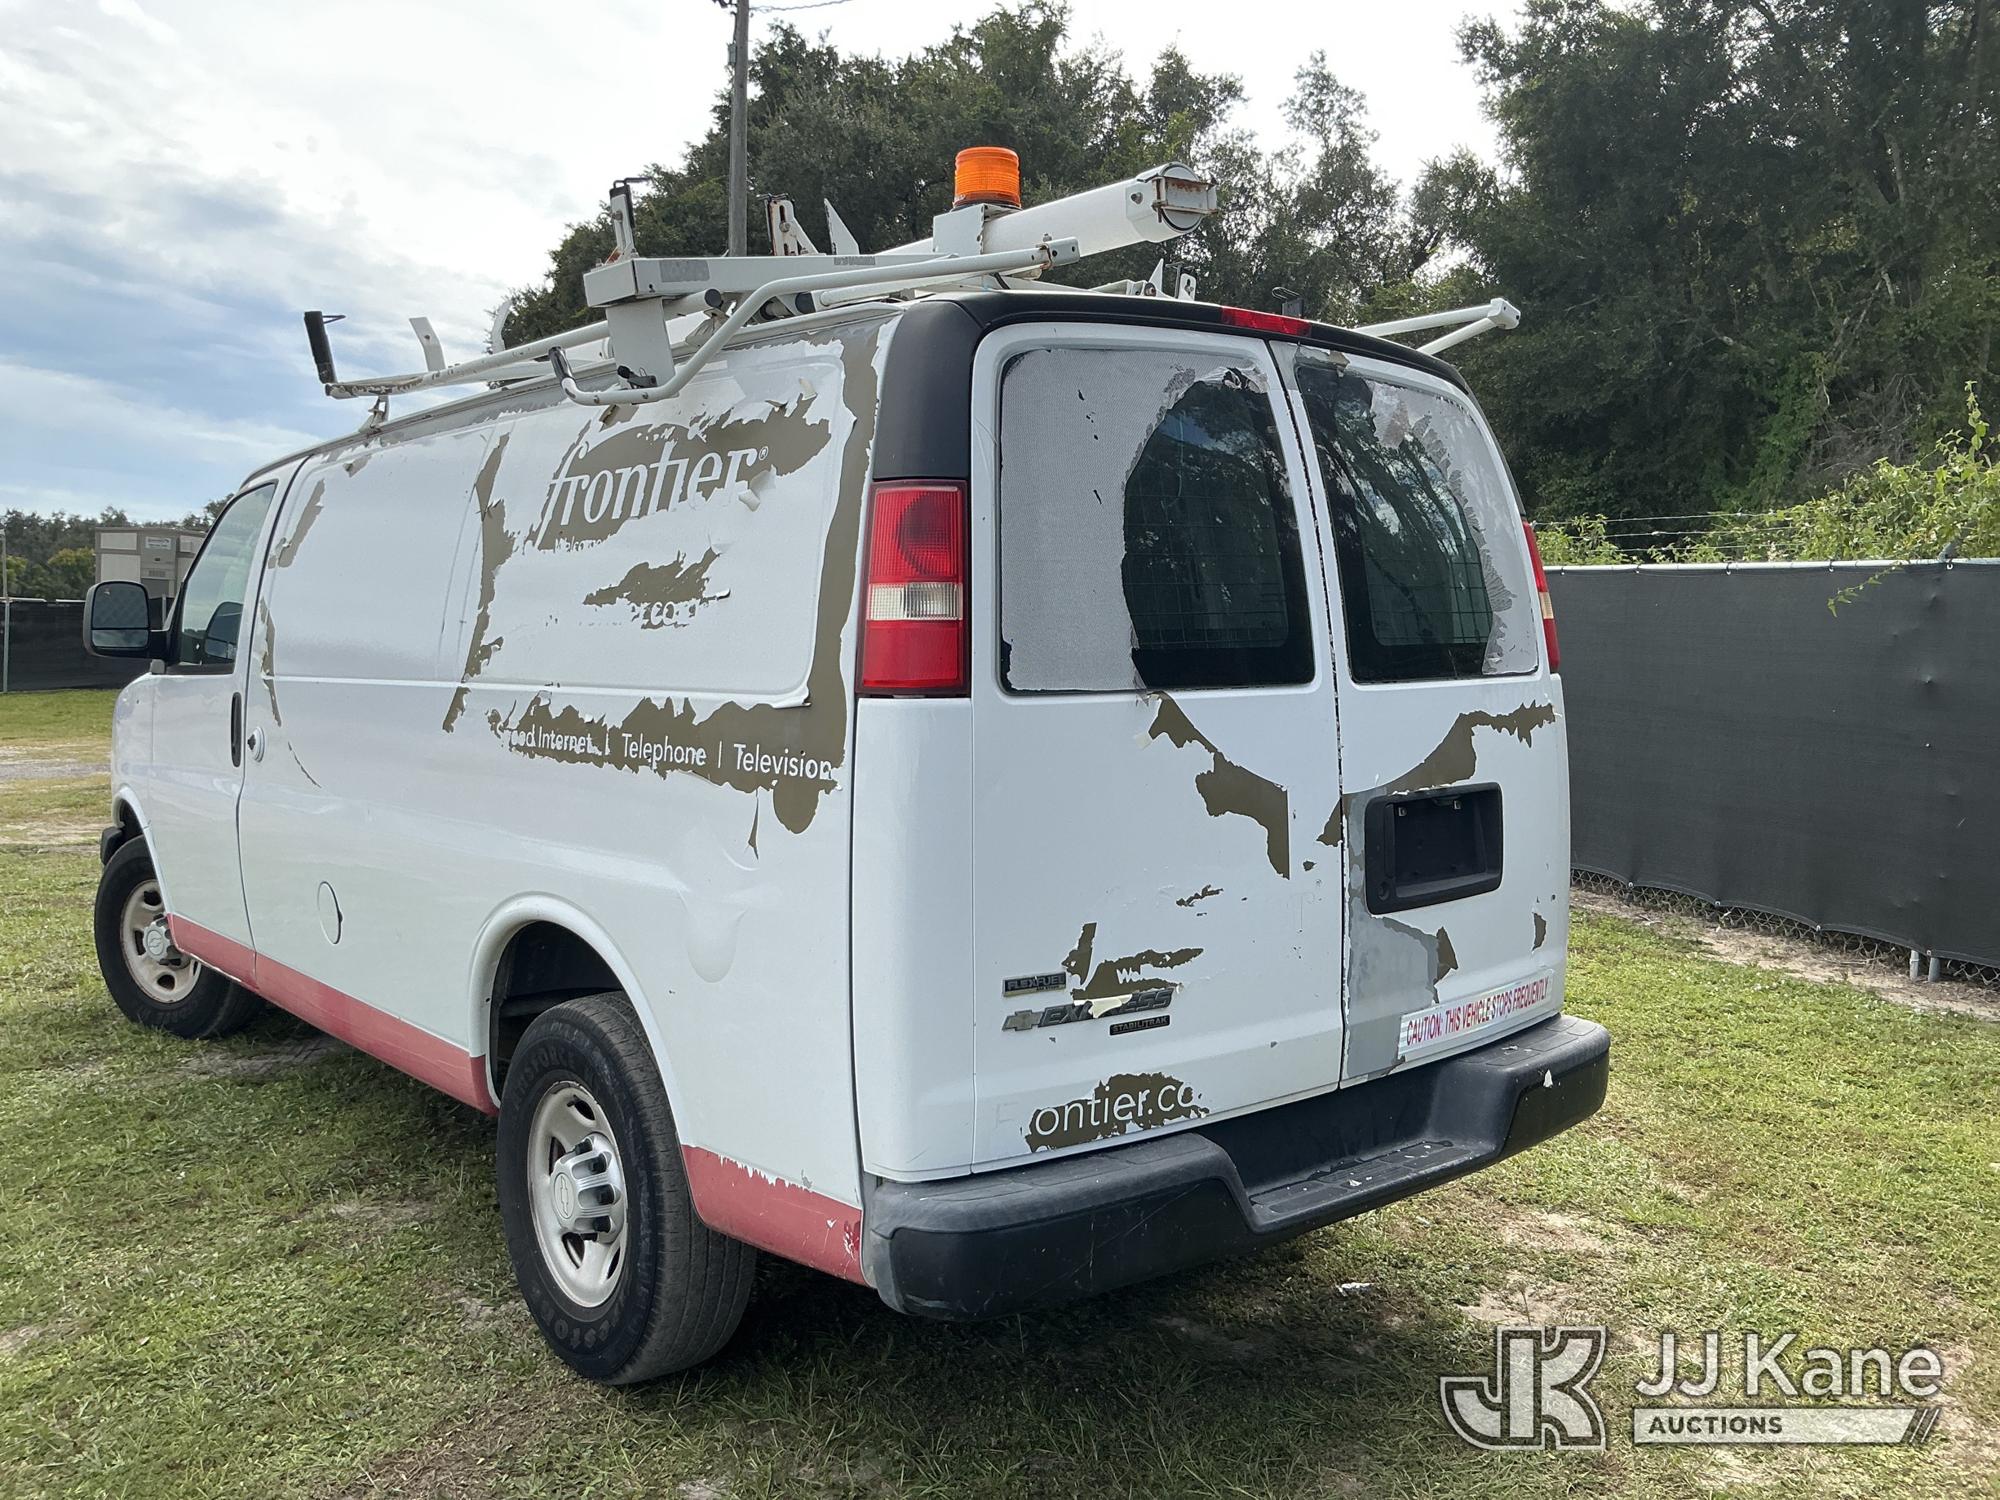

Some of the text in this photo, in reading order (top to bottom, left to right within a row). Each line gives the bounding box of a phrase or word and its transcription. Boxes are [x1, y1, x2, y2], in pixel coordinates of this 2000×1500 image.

[538, 726, 596, 754] Internet
[622, 732, 707, 769] Telephone
[733, 743, 833, 780] Television
[1111, 1016, 1168, 1034] STABILITRAK
[1406, 976, 1550, 1046] CAUTION: THIS VEHICLE STOPS FREQUENTLY
